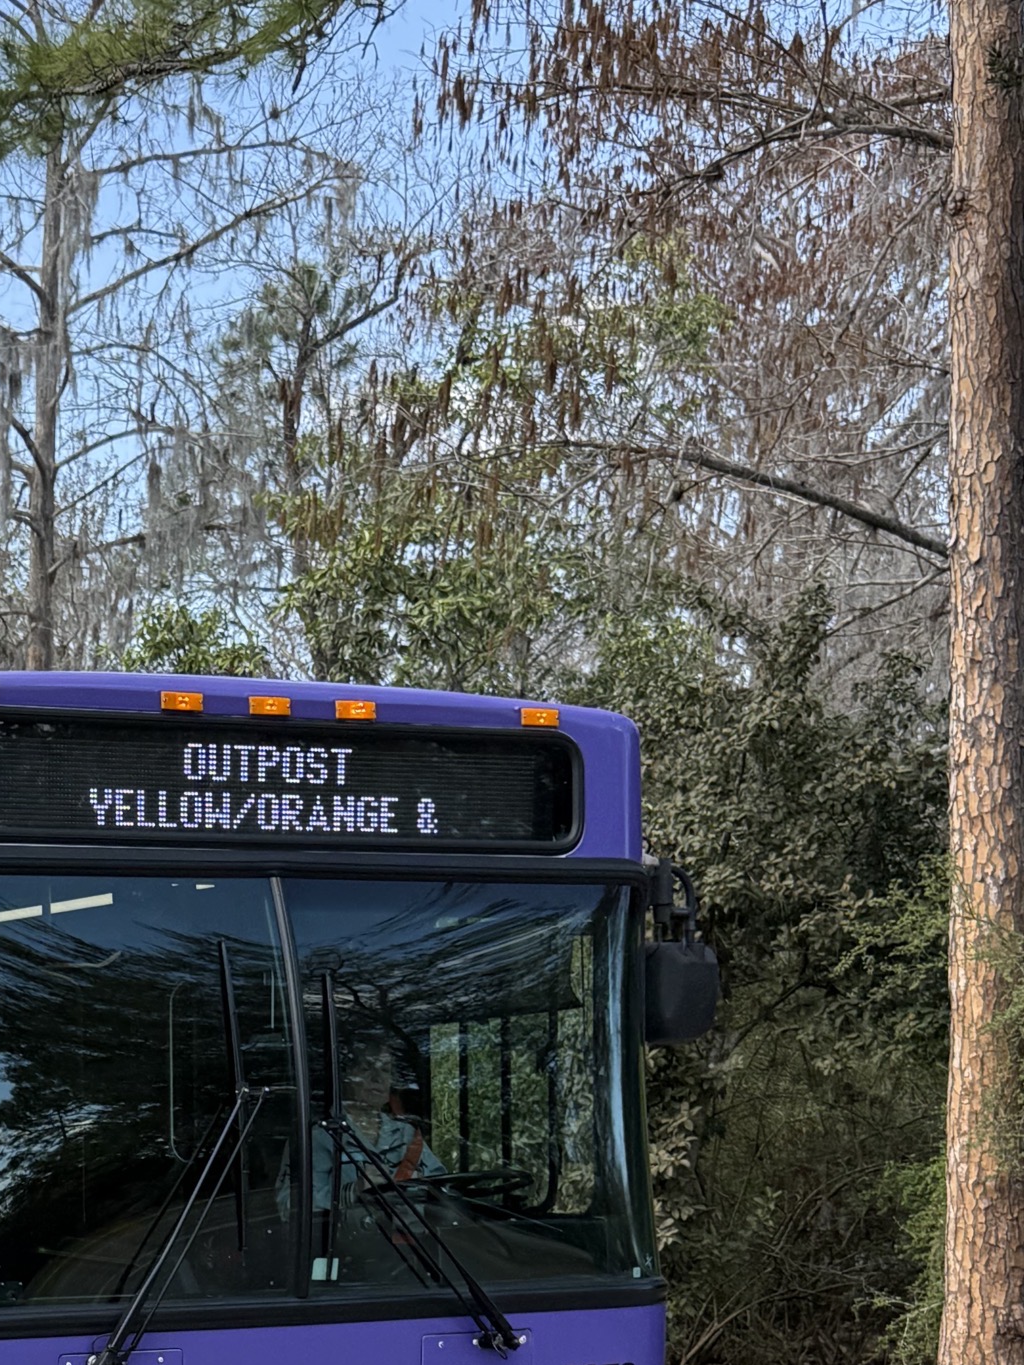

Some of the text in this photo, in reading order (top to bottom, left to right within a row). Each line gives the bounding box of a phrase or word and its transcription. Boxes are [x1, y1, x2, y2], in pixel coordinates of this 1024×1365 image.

[183, 742, 353, 786] OUTPOST
[89, 787, 439, 834] YELLOW/ORANGE &
